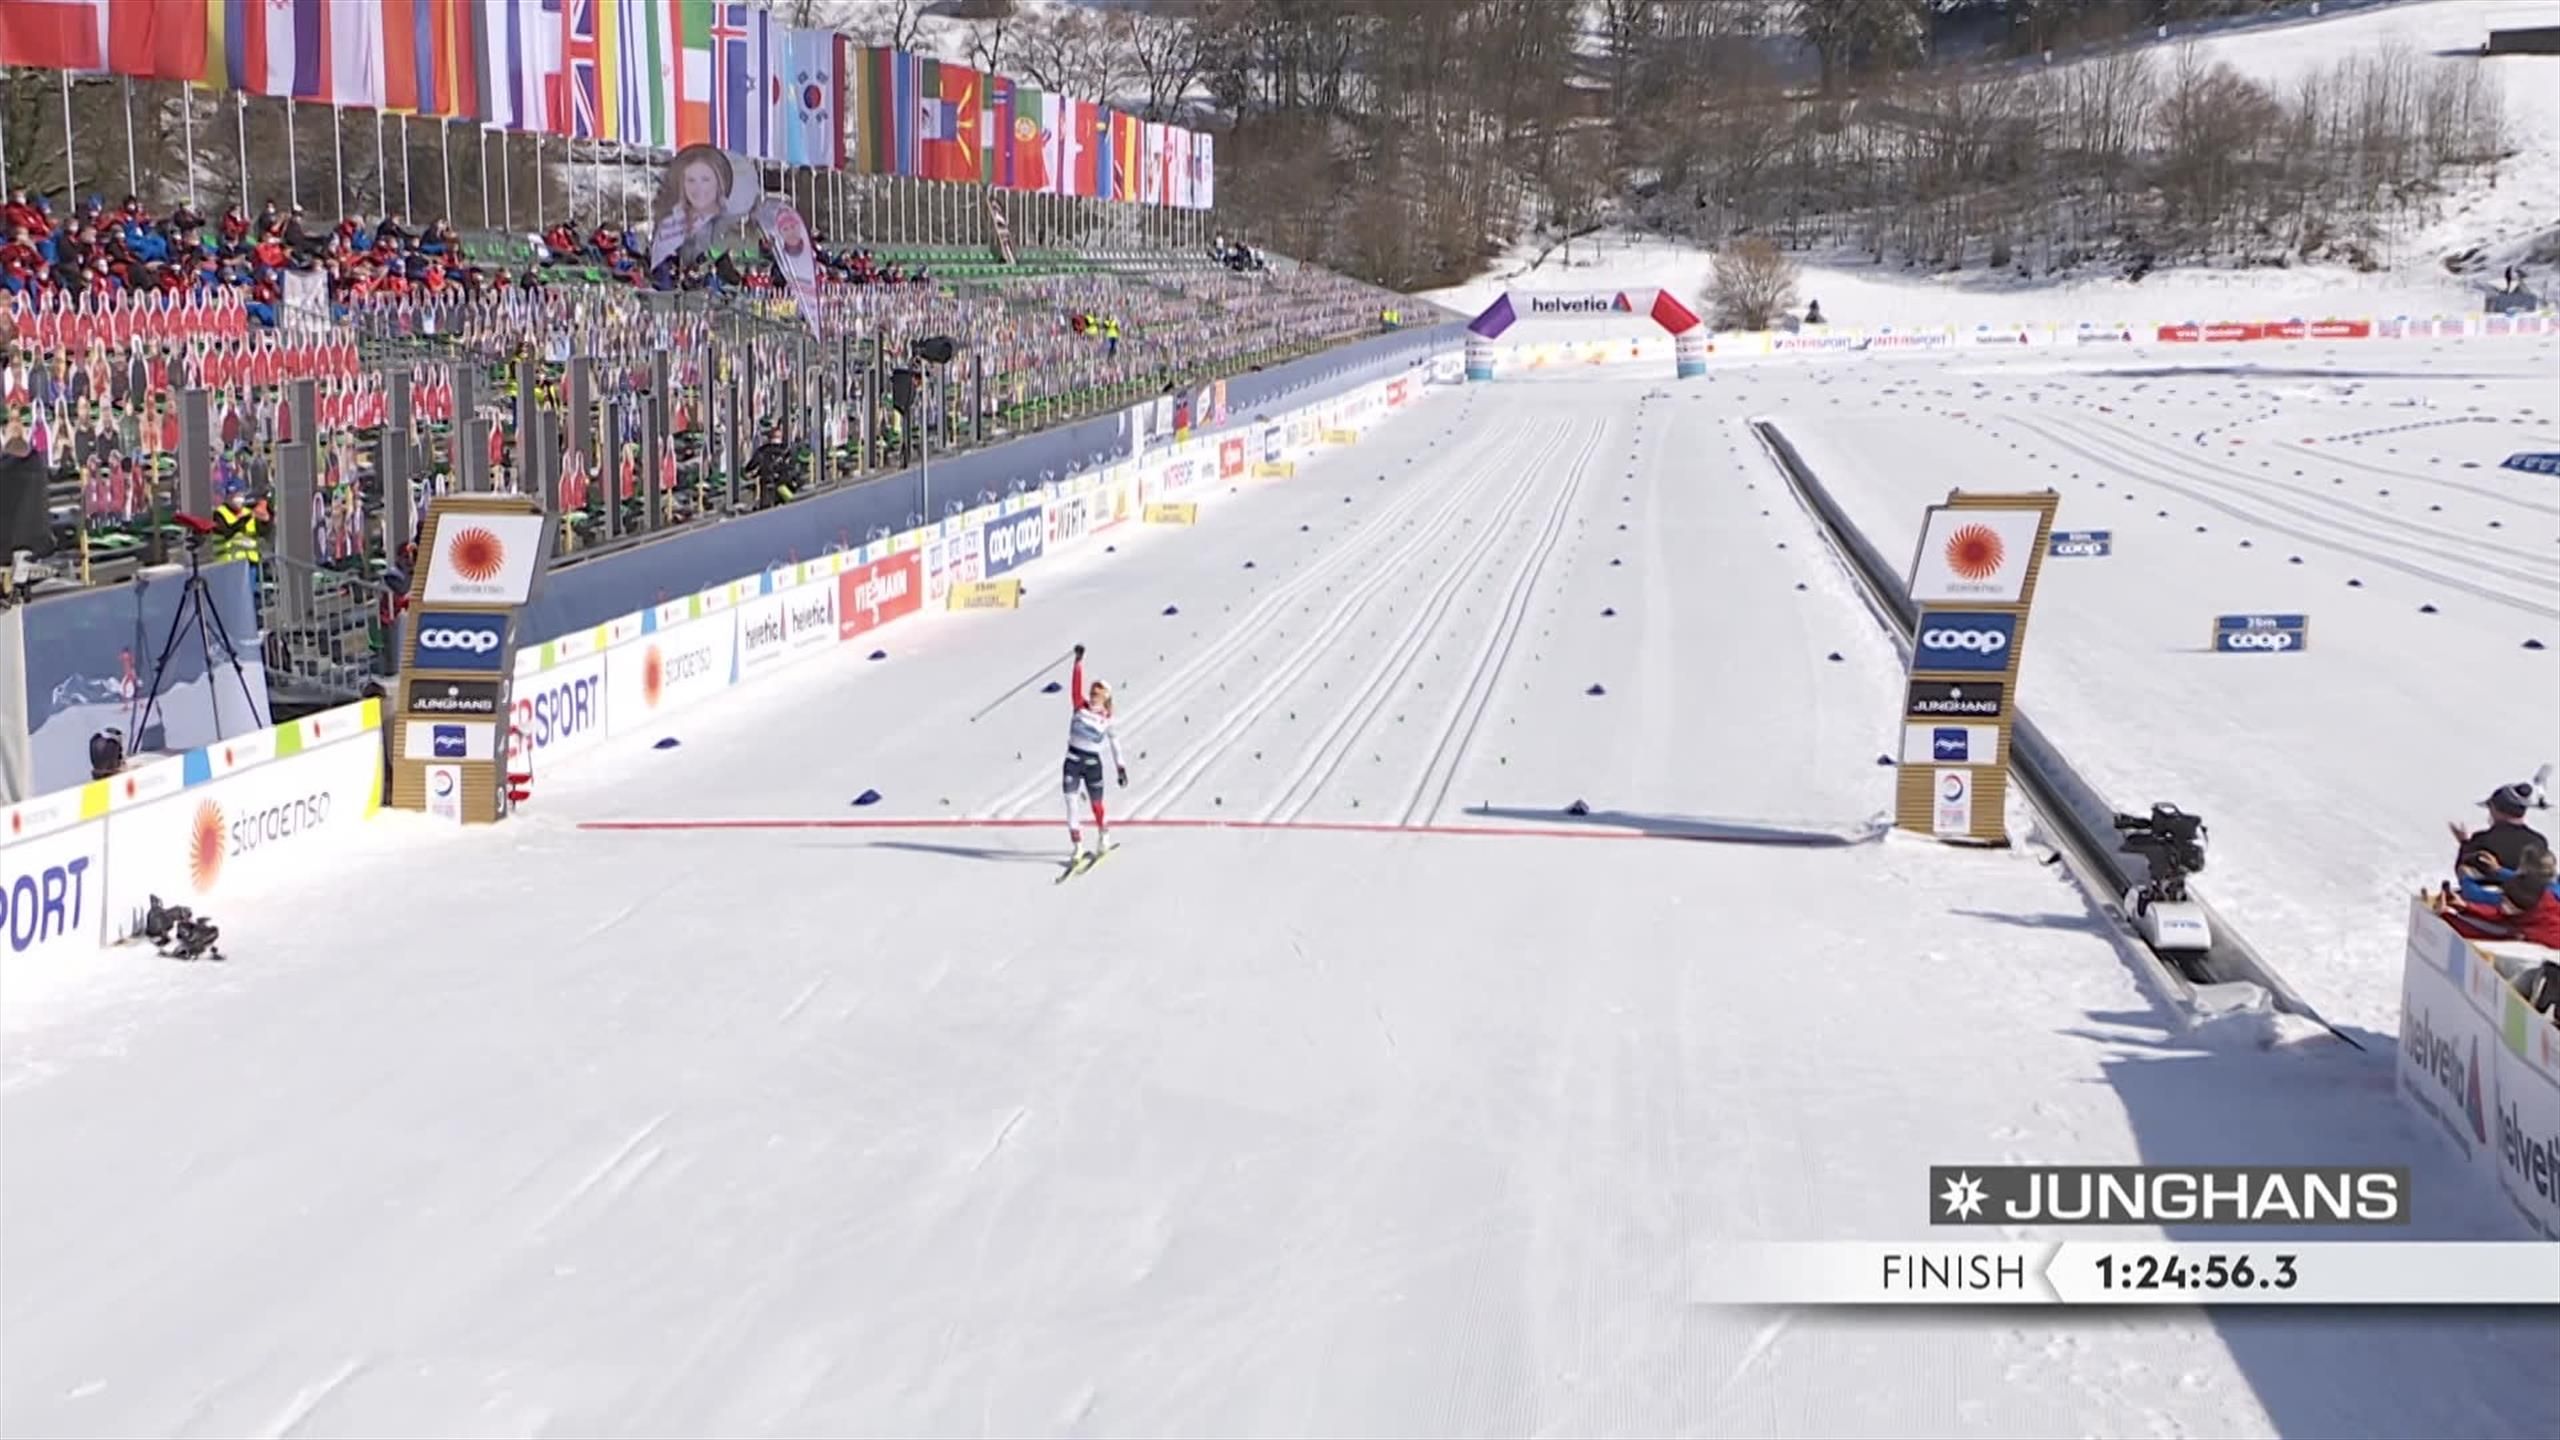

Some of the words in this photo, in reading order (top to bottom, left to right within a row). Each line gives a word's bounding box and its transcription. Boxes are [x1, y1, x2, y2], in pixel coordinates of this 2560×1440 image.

[1532, 297, 1608, 312] helvetia
[989, 524, 1015, 565] coop
[1016, 515, 1041, 555] coop
[420, 628, 499, 652] coop
[1922, 628, 2006, 655] coop
[2227, 633, 2292, 651] coop
[1913, 701, 1997, 713] JUNGHANS
[230, 791, 331, 857] storaenso
